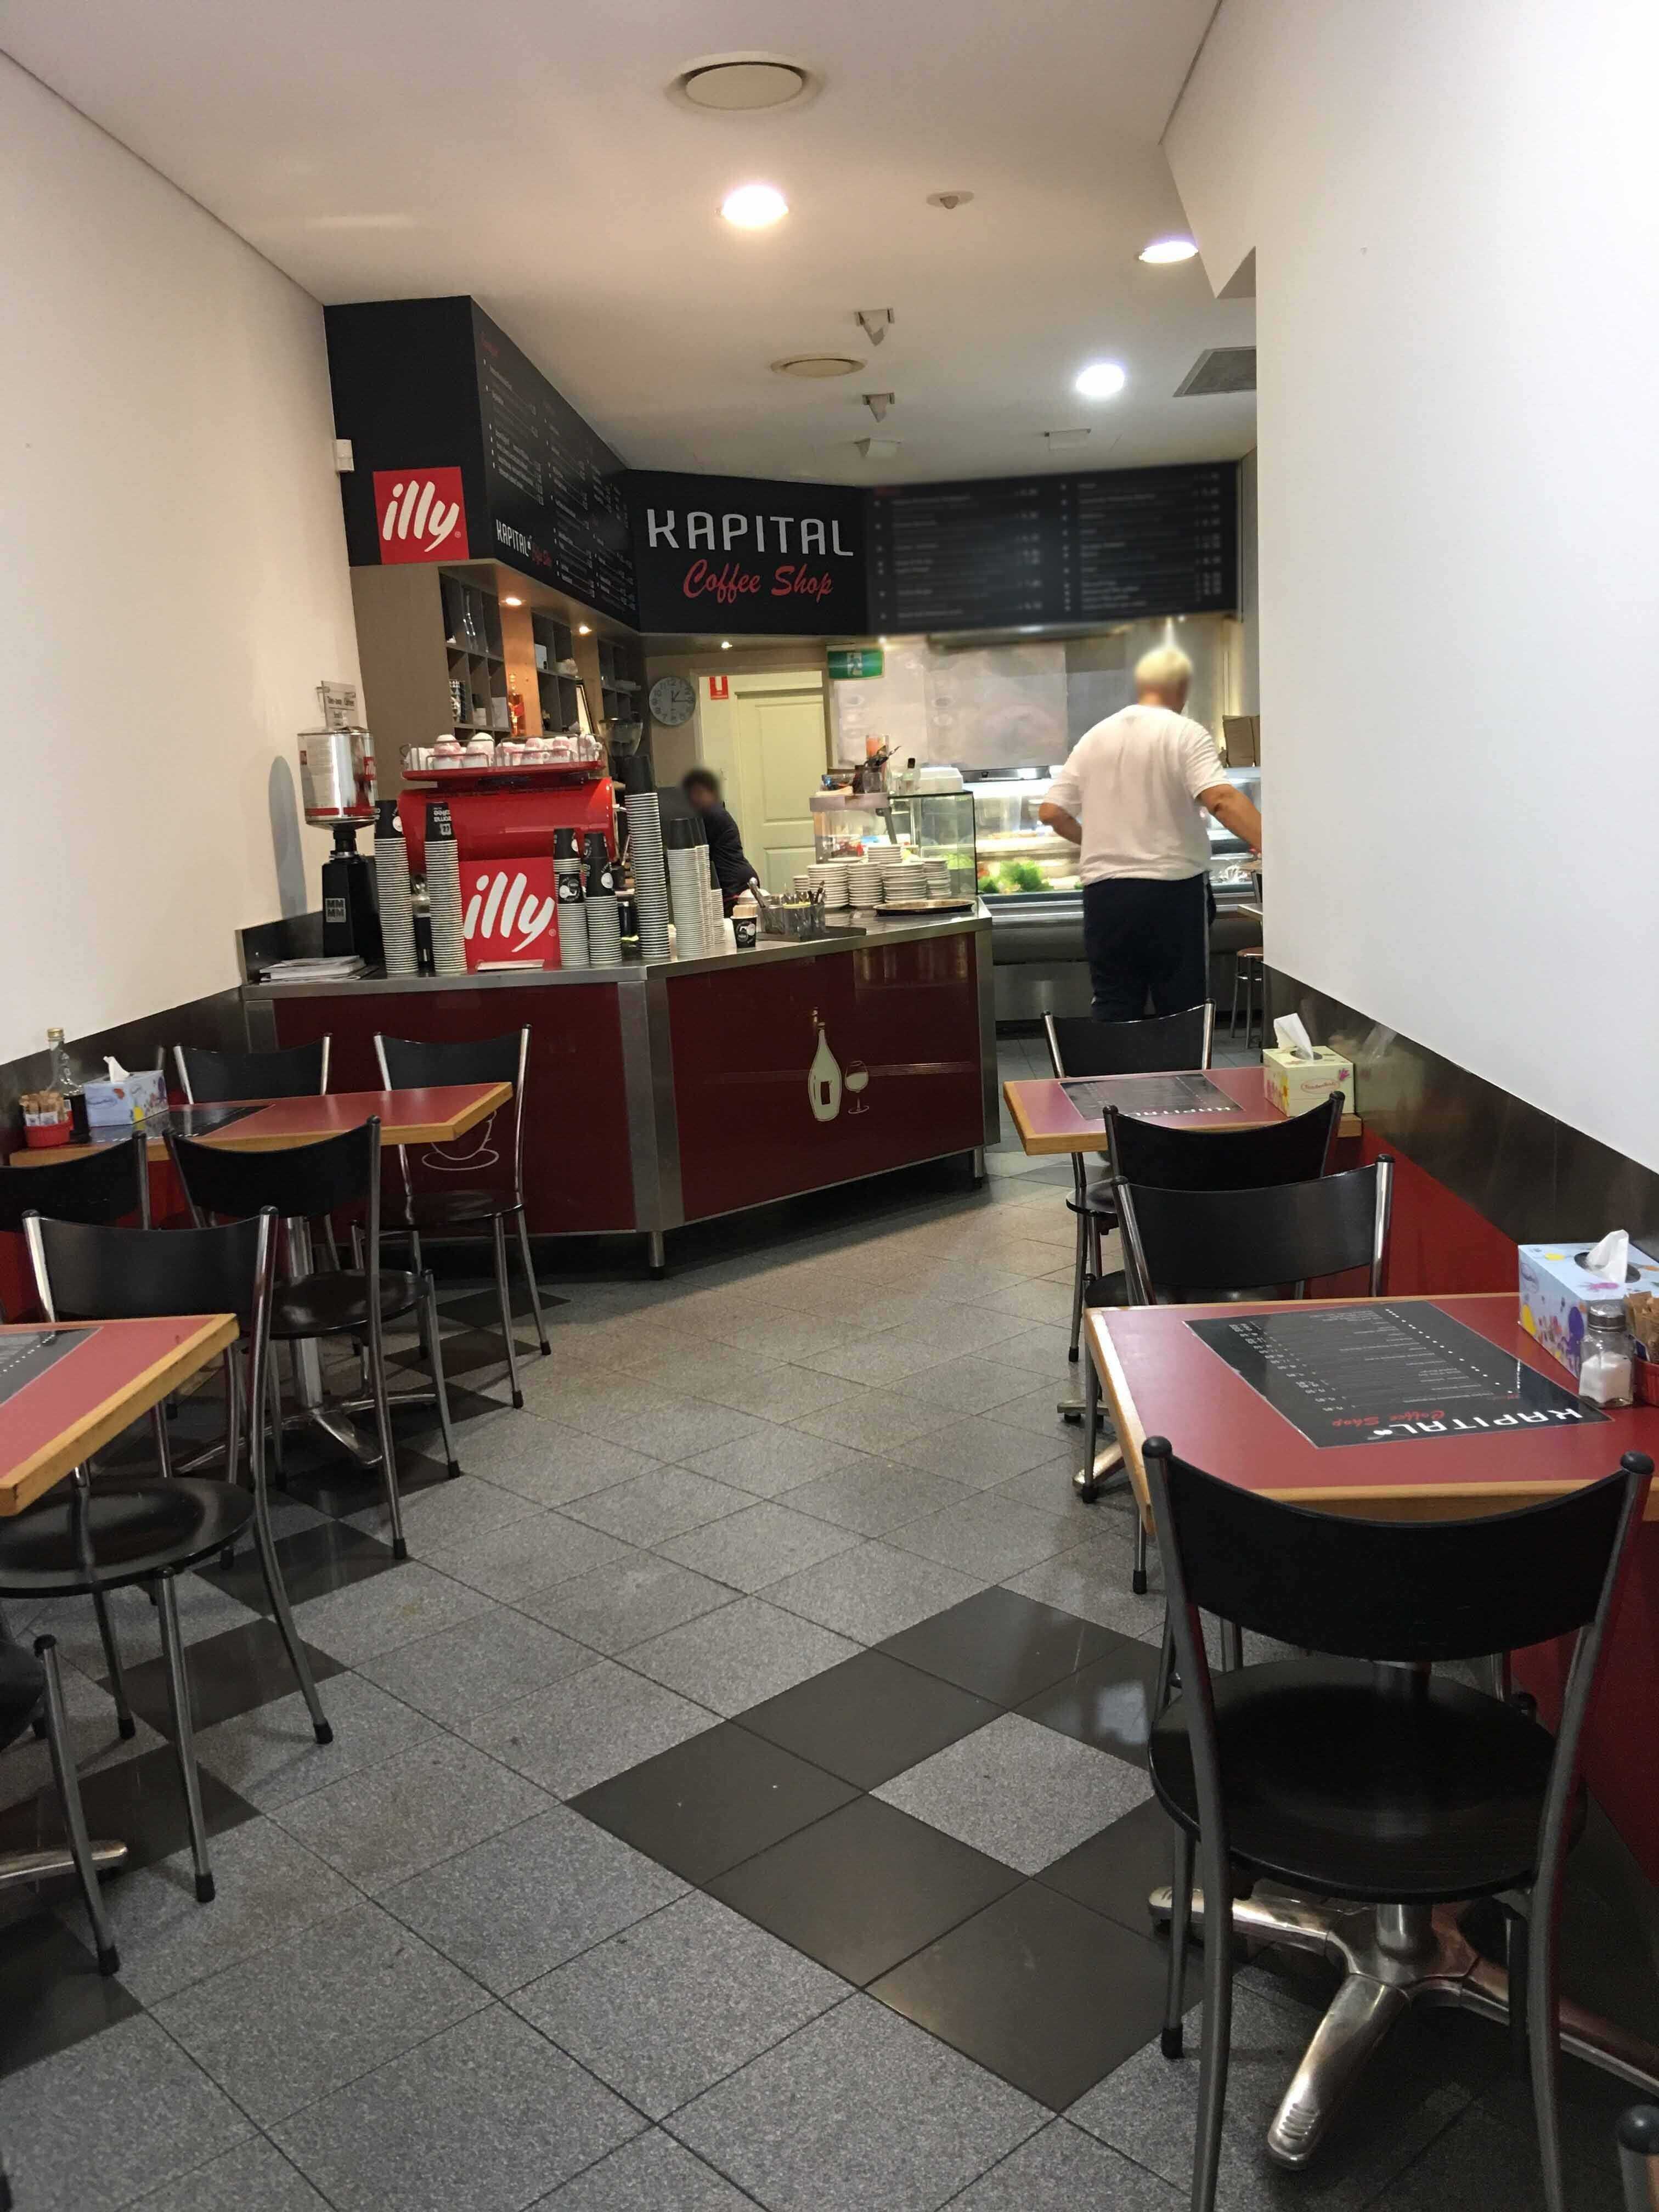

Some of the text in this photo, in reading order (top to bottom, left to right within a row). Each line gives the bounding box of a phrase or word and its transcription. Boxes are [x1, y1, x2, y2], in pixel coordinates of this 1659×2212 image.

[382, 480, 460, 552] illy
[496, 519, 529, 557] KAPITAL
[647, 509, 854, 556] KAPITAL
[683, 558, 761, 604] Coffee
[771, 563, 833, 603] Shop
[464, 872, 555, 952] illy
[1389, 1408, 1584, 1435] KAPITAL
